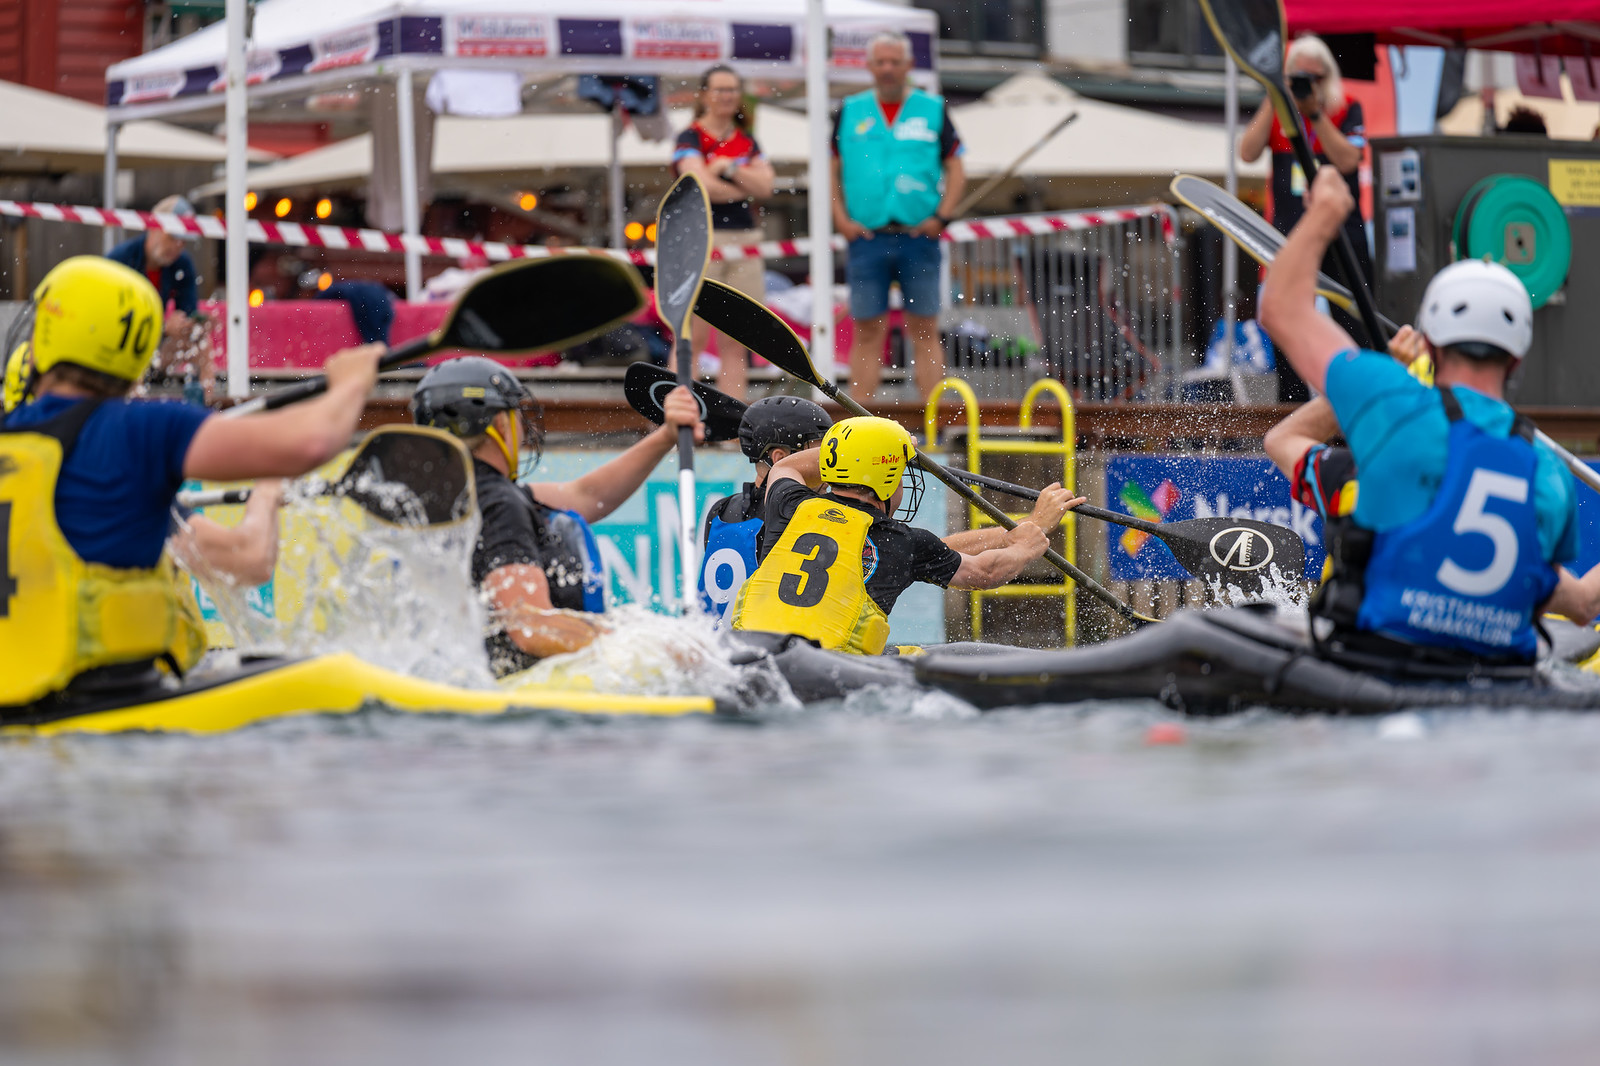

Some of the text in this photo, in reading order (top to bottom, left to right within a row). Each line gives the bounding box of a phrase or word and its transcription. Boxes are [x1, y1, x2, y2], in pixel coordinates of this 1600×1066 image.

[119, 309, 154, 358] 10
[825, 437, 838, 469] 3
[778, 532, 839, 608] 3
[1436, 467, 1528, 597] 5
[704, 548, 747, 631] 9
